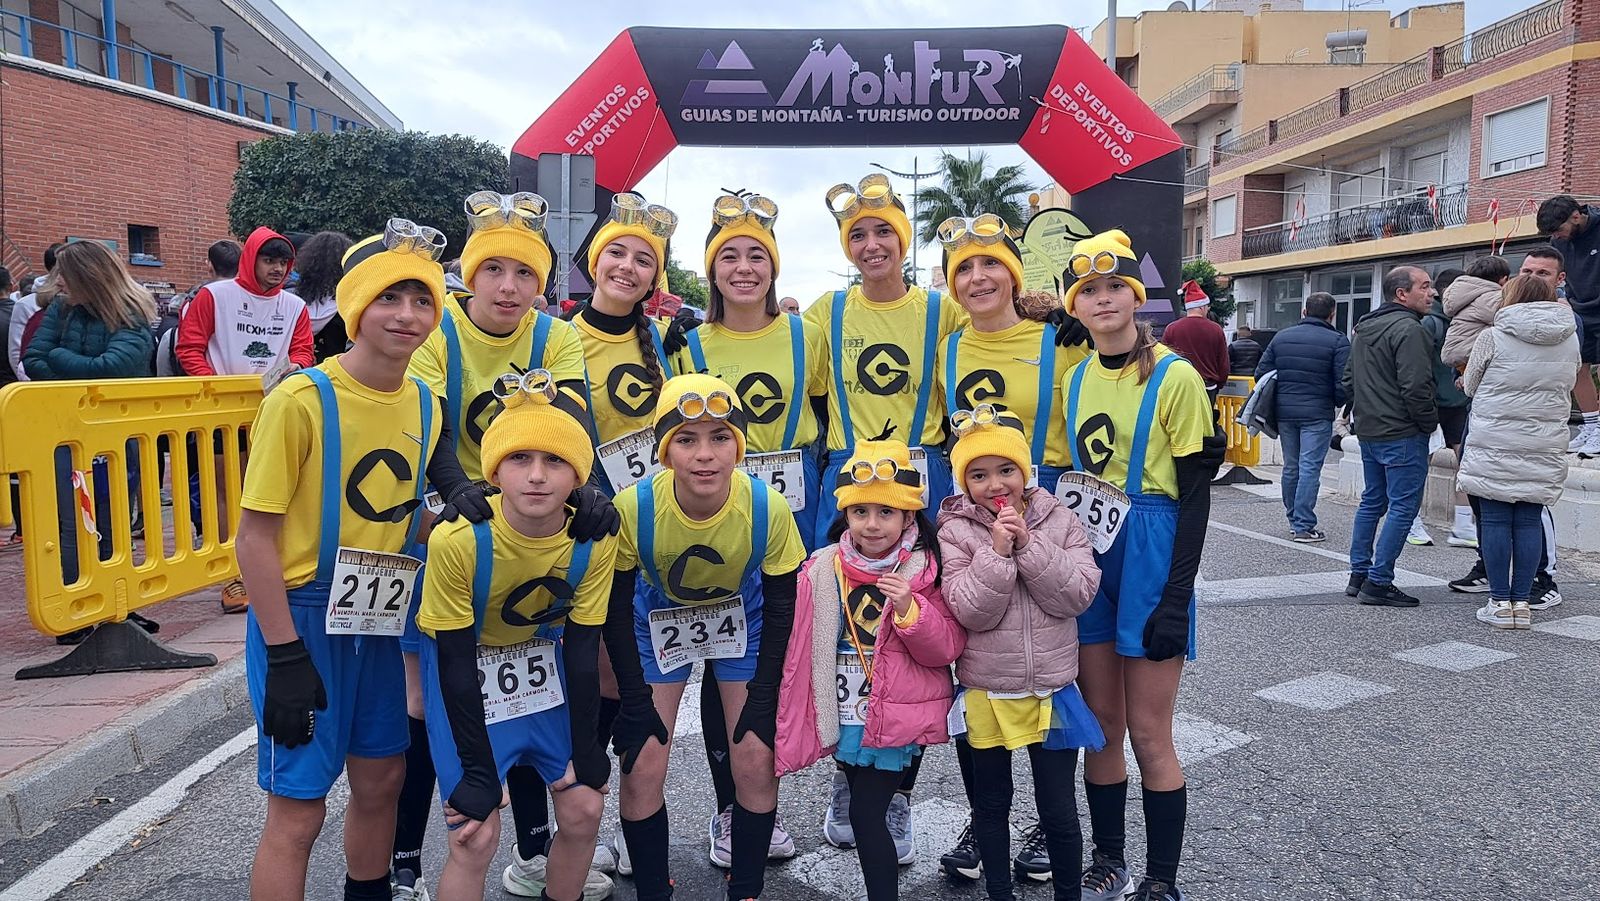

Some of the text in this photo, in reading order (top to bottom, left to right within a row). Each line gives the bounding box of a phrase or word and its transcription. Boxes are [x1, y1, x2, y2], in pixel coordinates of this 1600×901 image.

[565, 84, 626, 147] EVENTOS
[576, 87, 649, 155] PORTIVOS
[681, 109, 732, 122] GUIAS
[736, 109, 757, 122] DE
[762, 106, 844, 123] MONTAÑA
[857, 109, 933, 122] TURISMO
[937, 107, 1020, 121] OUTDOOR
[1050, 84, 1132, 166] DEPORTIVOS
[1073, 82, 1134, 143] EVENTOS
[1065, 490, 1121, 534] 259
[337, 574, 405, 611] 212
[661, 615, 737, 651] 234
[477, 655, 547, 700] 265
